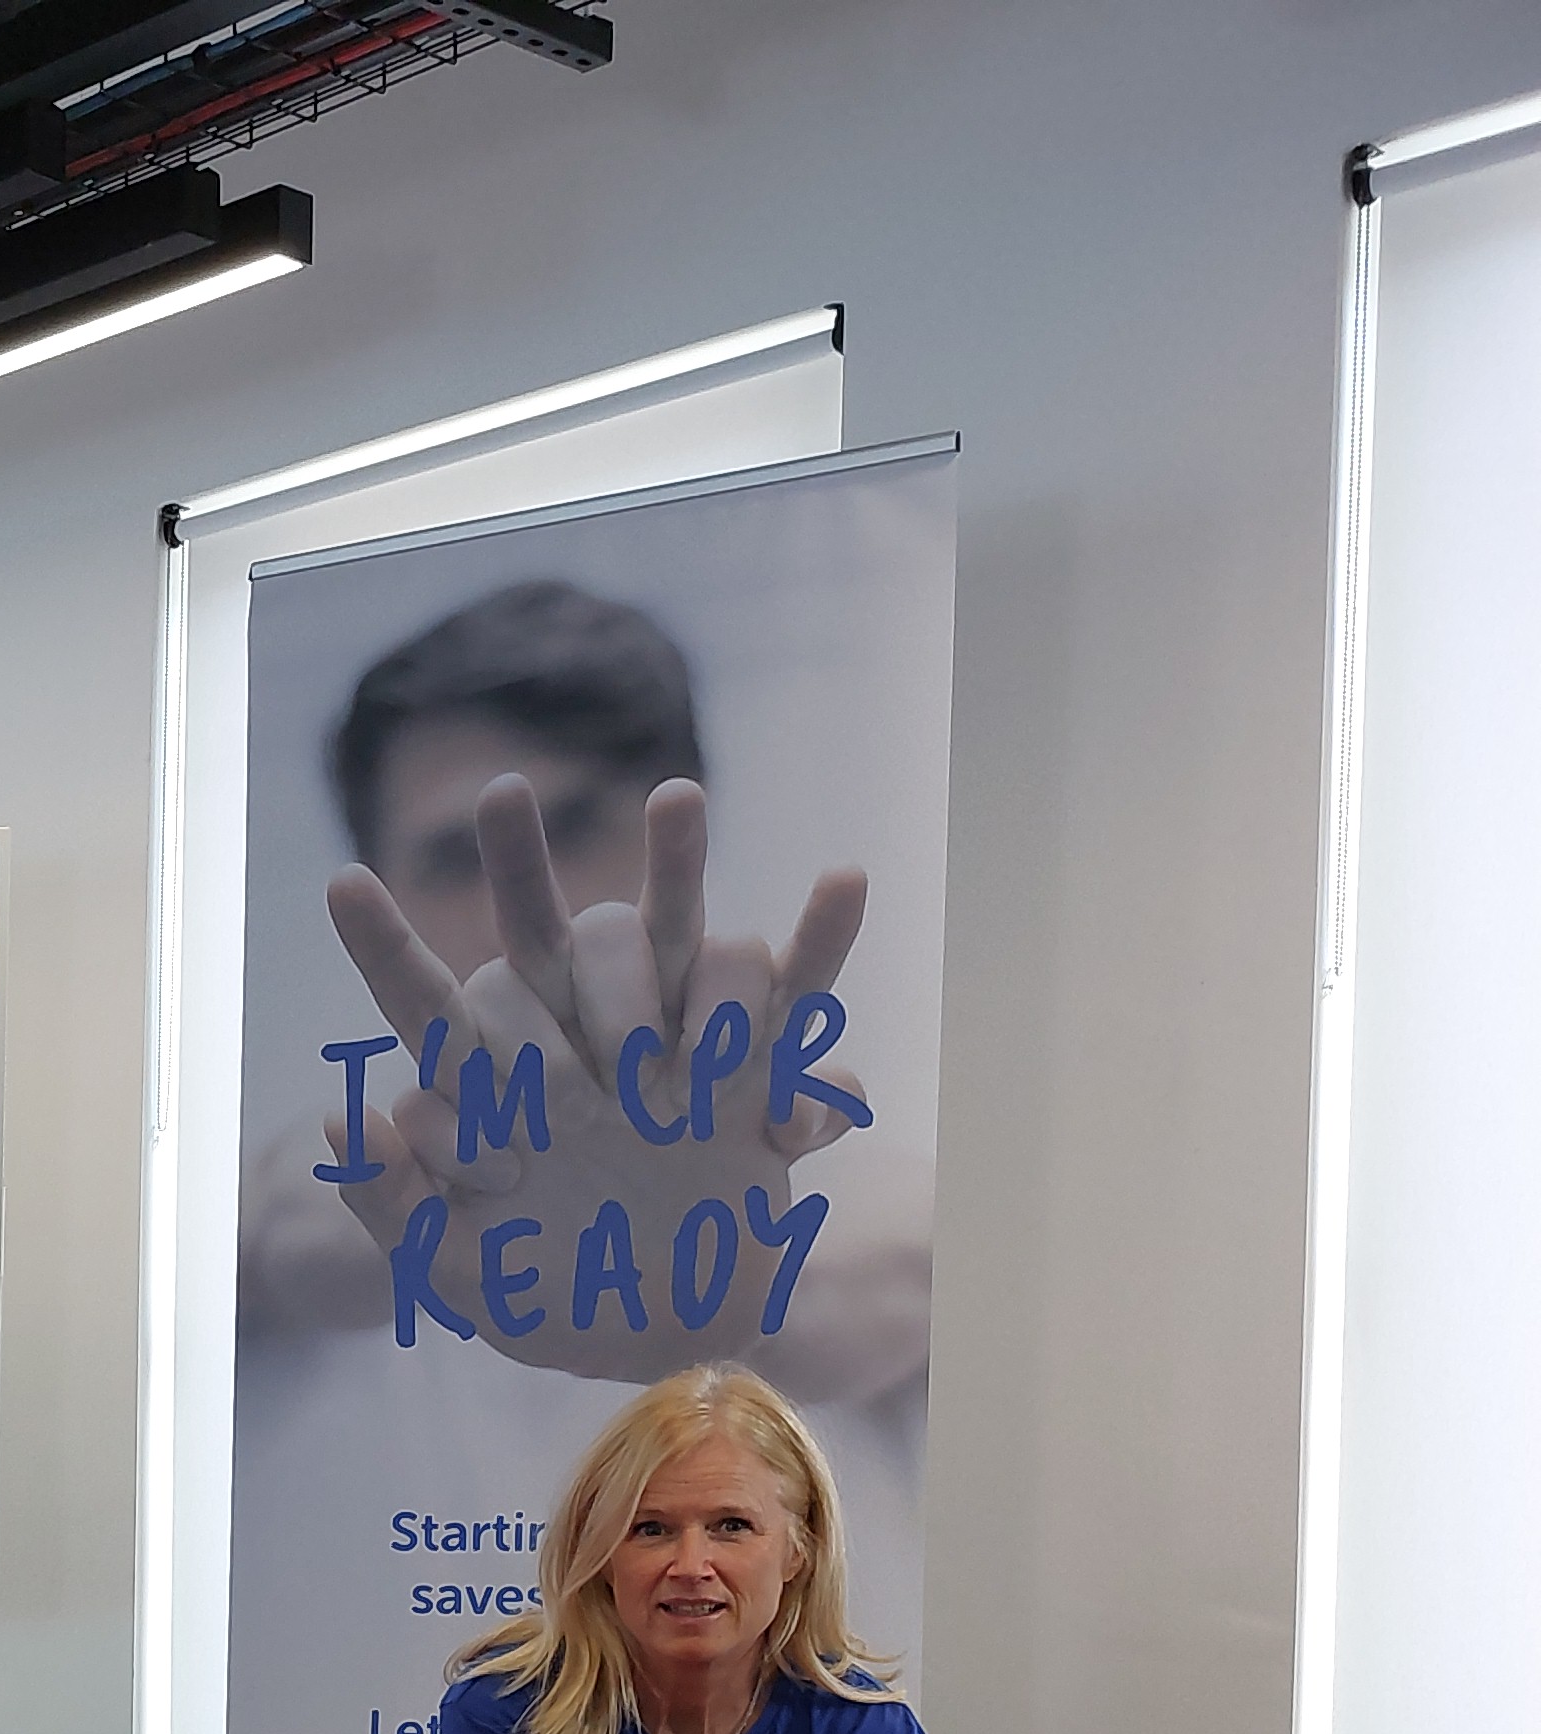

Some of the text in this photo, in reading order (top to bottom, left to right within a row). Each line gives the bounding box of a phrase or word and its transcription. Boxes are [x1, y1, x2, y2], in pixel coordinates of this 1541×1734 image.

[312, 992, 874, 1183] I'M CPR
[390, 1186, 829, 1348] READY
